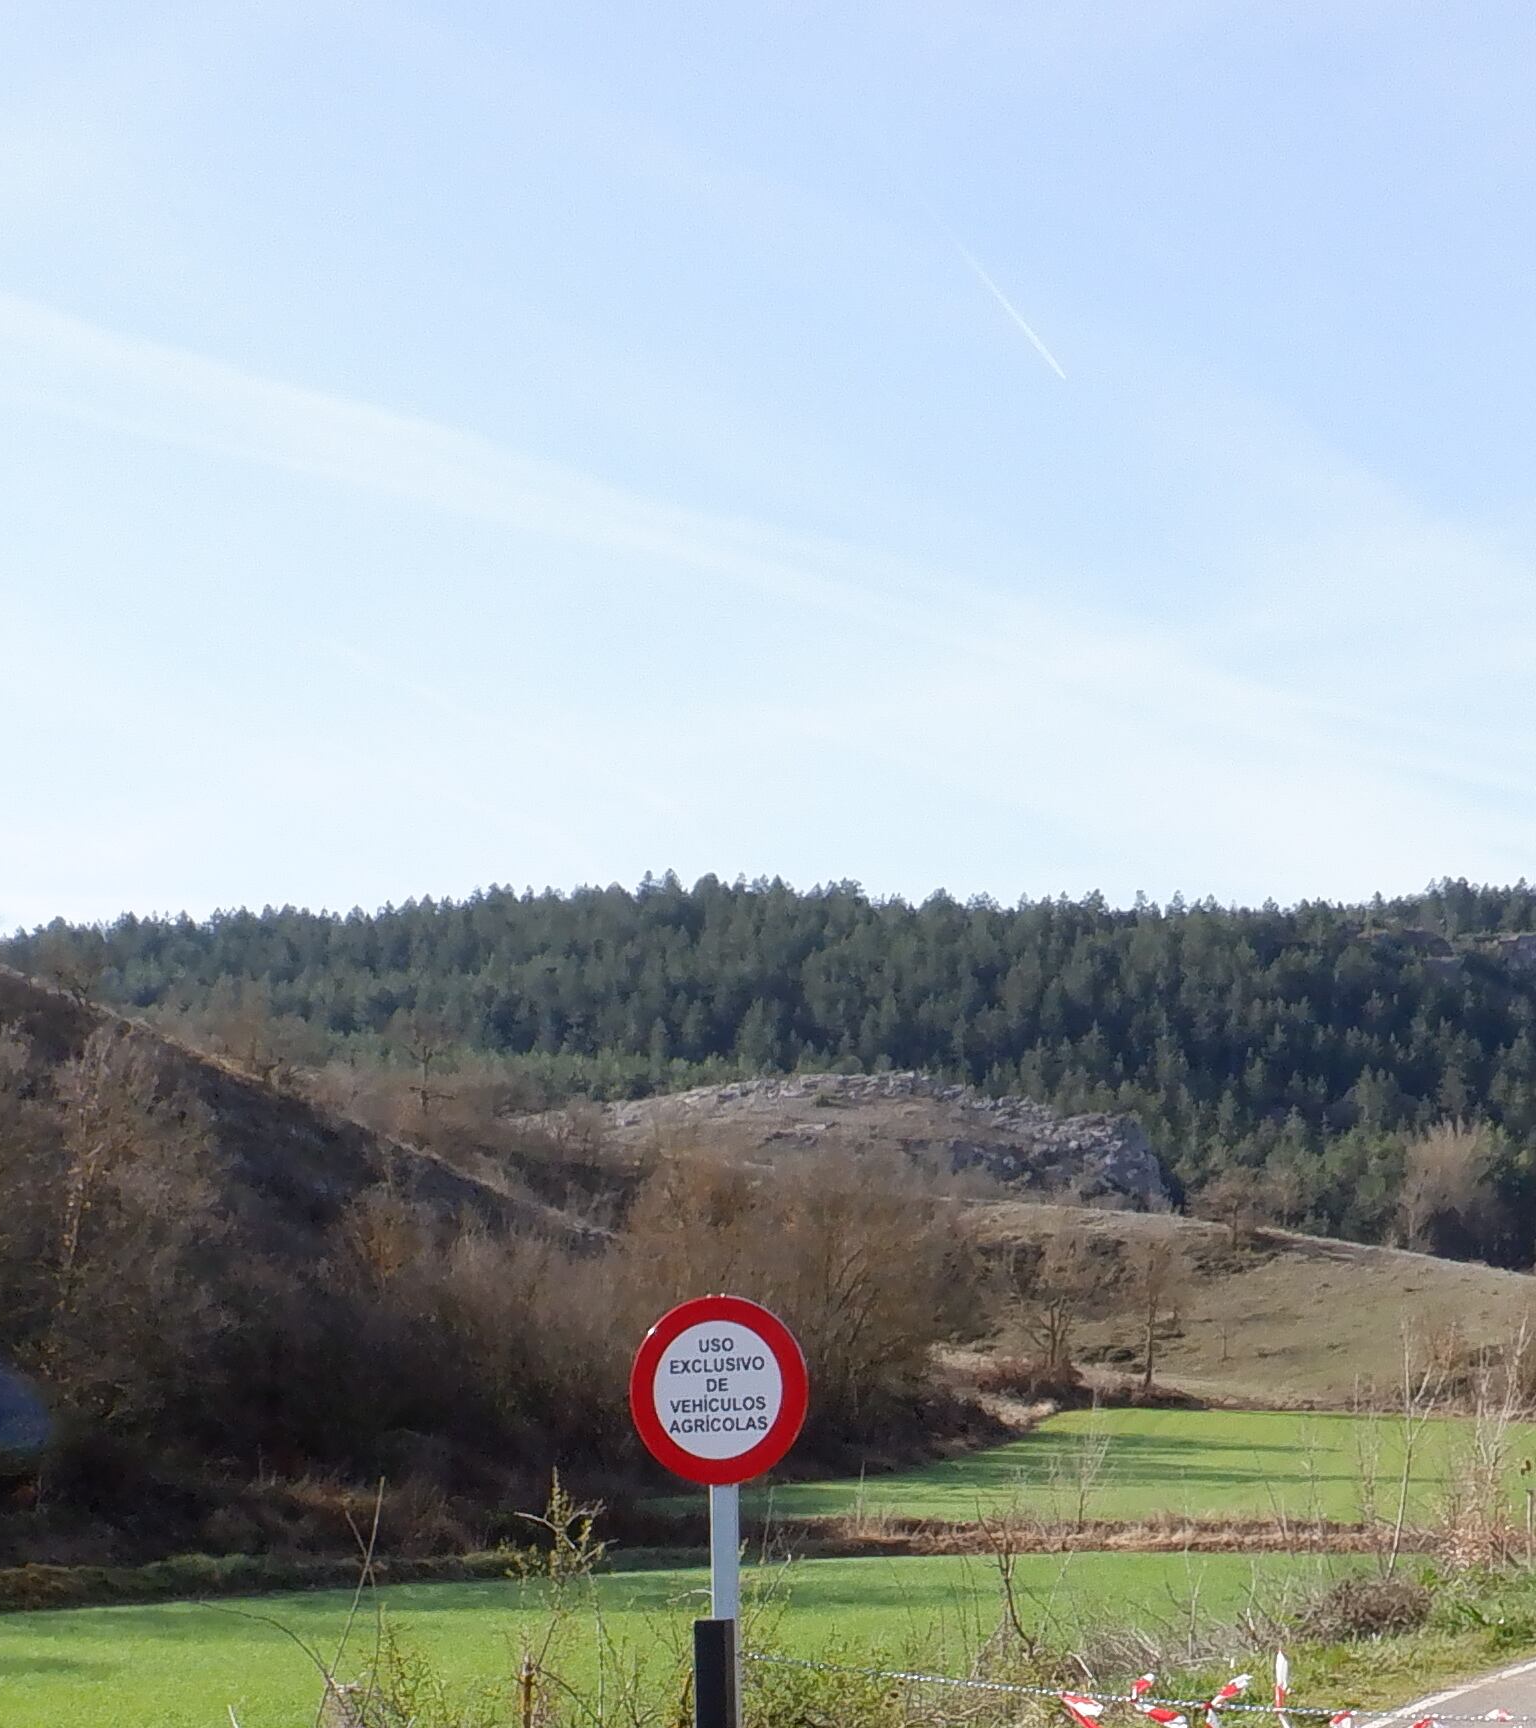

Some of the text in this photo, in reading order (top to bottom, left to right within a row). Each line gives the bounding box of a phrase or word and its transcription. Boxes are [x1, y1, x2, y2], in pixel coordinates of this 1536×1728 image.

[699, 1337, 734, 1353] USO
[670, 1356, 765, 1374] EXCLUSIVO
[706, 1378, 729, 1392] DE
[670, 1395, 766, 1413] VEHÍCULOS
[669, 1415, 768, 1434] AGRÍCOLAS
